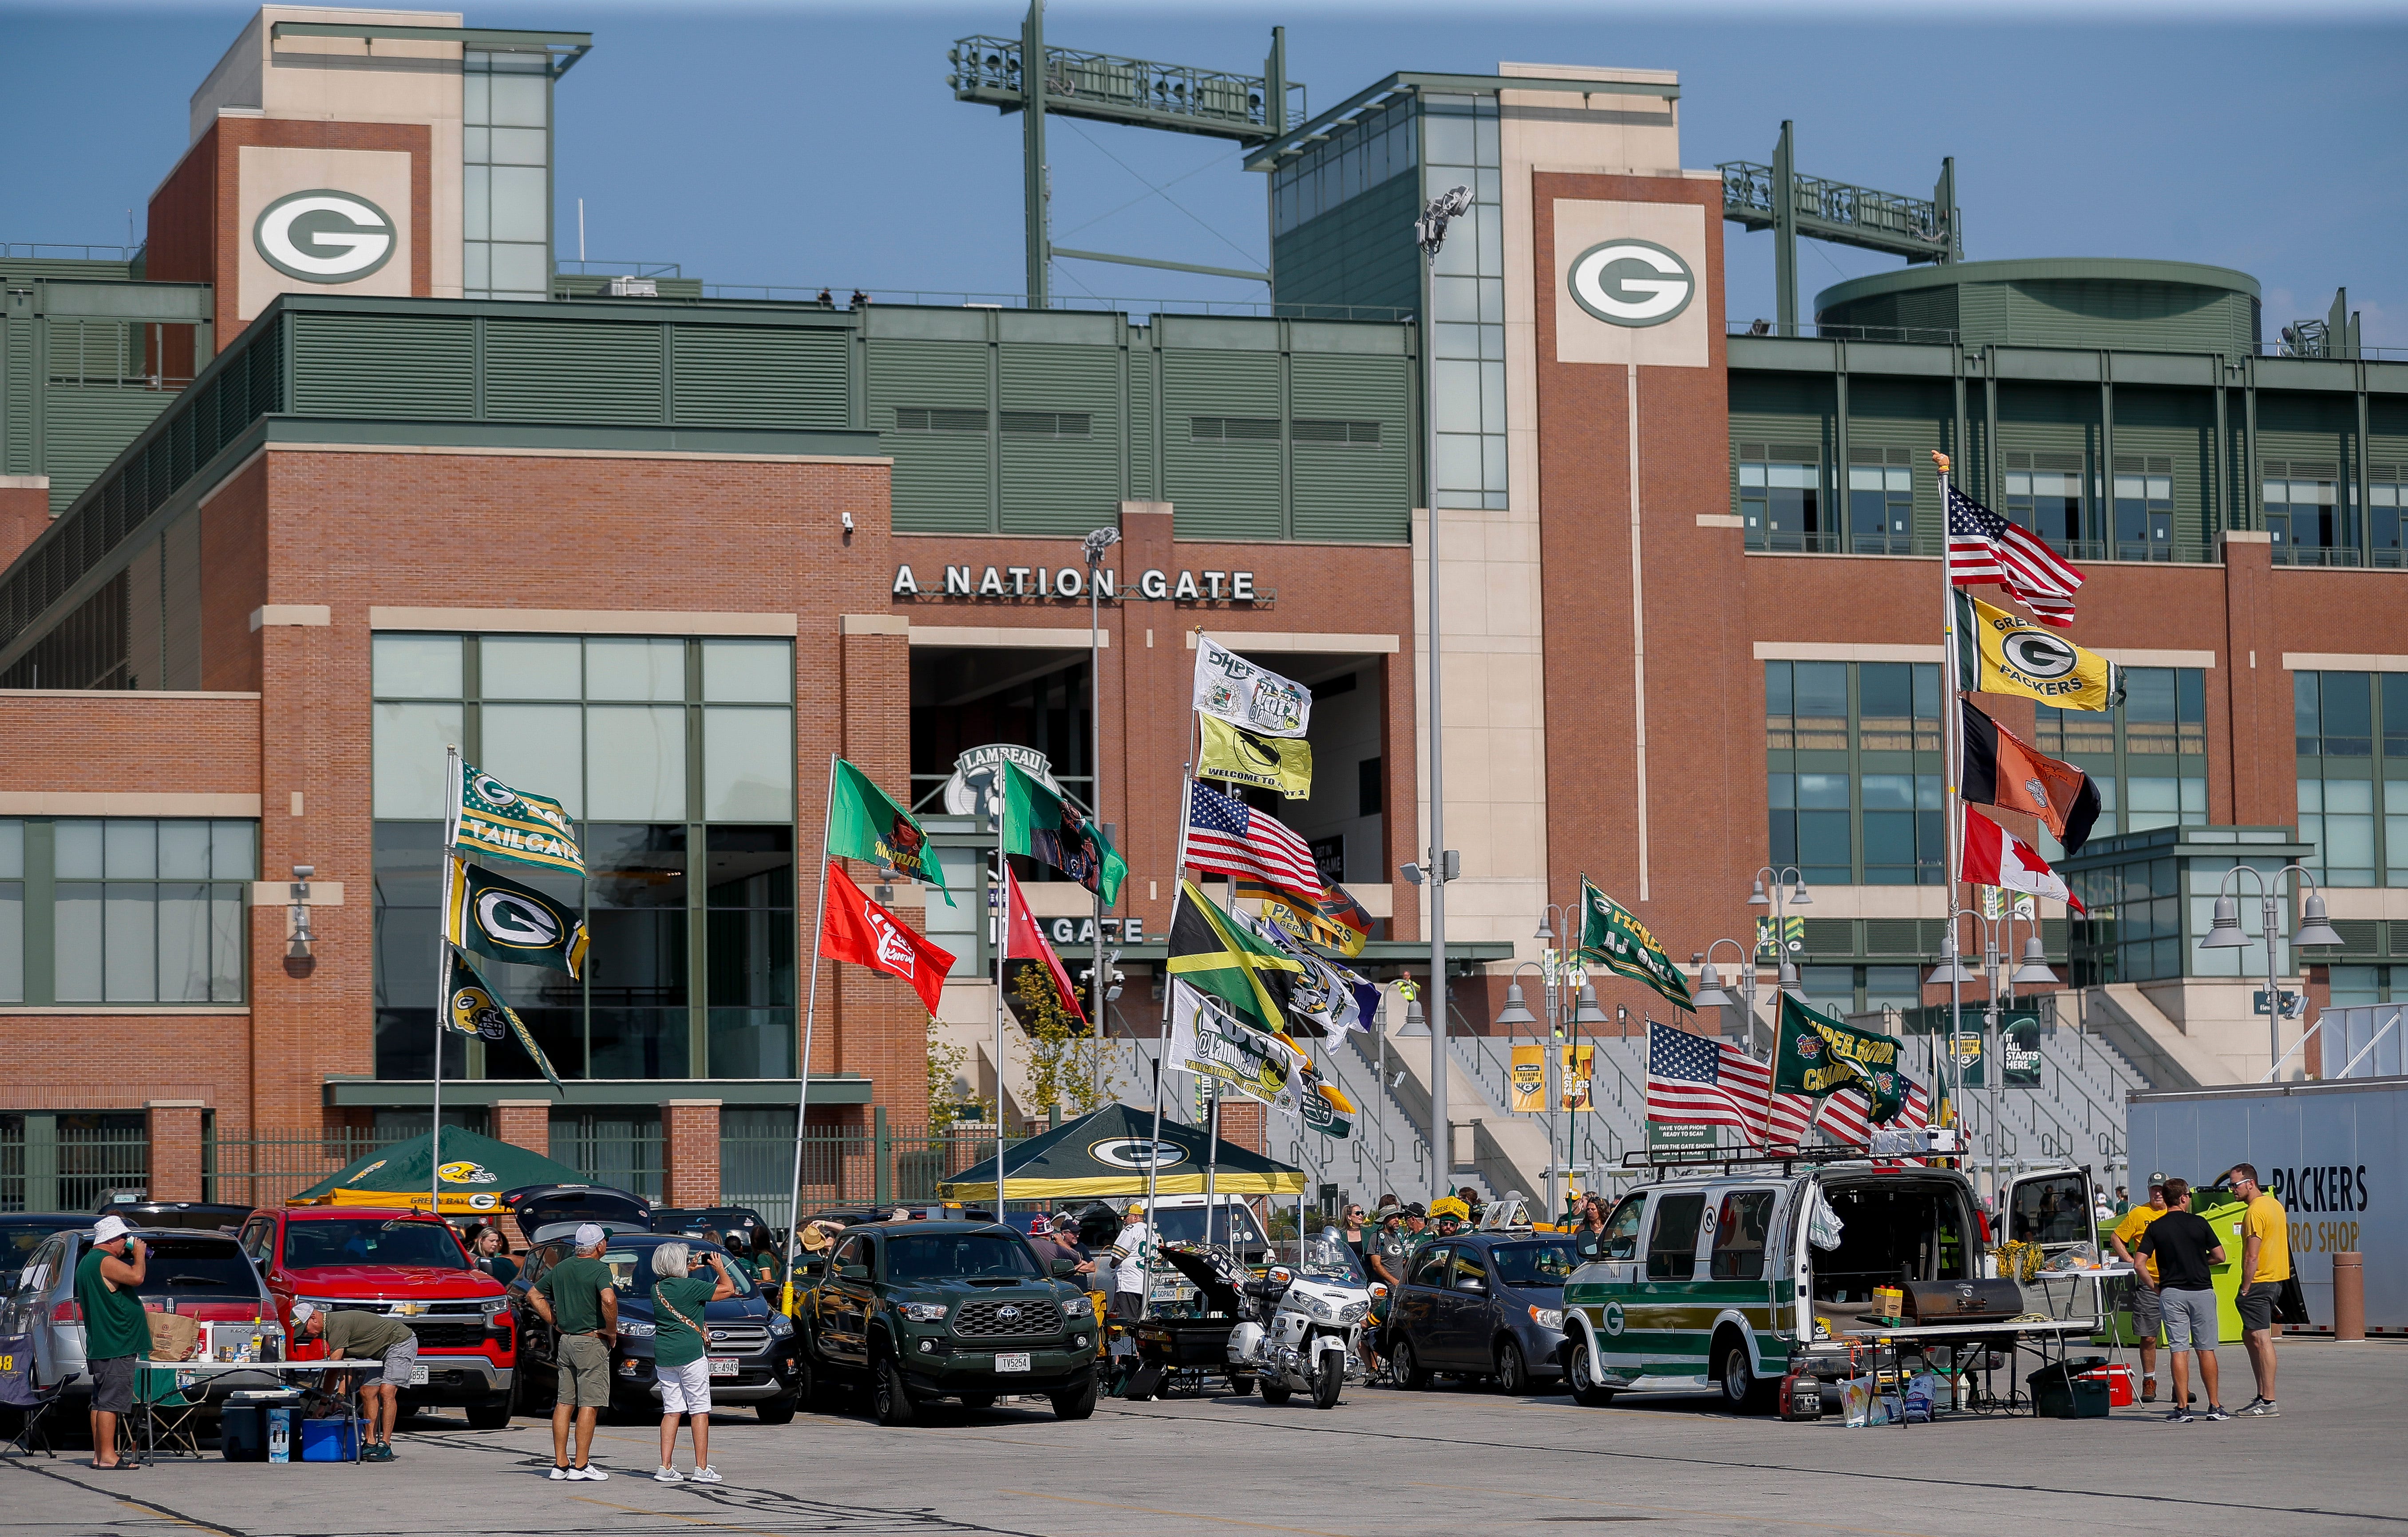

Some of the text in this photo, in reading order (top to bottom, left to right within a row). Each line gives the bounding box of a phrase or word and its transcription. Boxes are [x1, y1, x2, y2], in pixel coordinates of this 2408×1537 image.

[946, 565, 1115, 598] NATION
[1141, 569, 1255, 601] GATE
[1999, 664, 2083, 696] PACKERS
[963, 747, 1041, 770] LAMBEAU
[1208, 768, 1259, 782] WELCOME
[1261, 777, 1275, 786] TO
[471, 819, 585, 866] TAILGATE
[1320, 856, 1342, 873] GAME
[1987, 884, 1996, 916] WELCO
[1053, 918, 1143, 943] GATE
[1271, 903, 1352, 942] PARS
[1603, 931, 1629, 954] AJ
[2005, 1033, 2014, 1043] IT
[2005, 1043, 2021, 1051] ALL
[1856, 1038, 1894, 1064] BOWL
[2006, 1051, 2039, 1060] STARTS
[2006, 1060, 2031, 1070] HERE.
[1185, 1059, 1234, 1080] TAILGATING
[1234, 1072, 1246, 1089] HALL
[1255, 1086, 1277, 1104] FAME
[2272, 1164, 2368, 1213] PACKERS
[1432, 1204, 1449, 1215] CHEESE
[2286, 1221, 2360, 1253] RO SHOP
[0, 1355, 13, 1371] 8
[708, 1363, 738, 1372] DE-4949
[1003, 1358, 1027, 1367] TV5254
[410, 1370, 425, 1380] 855
